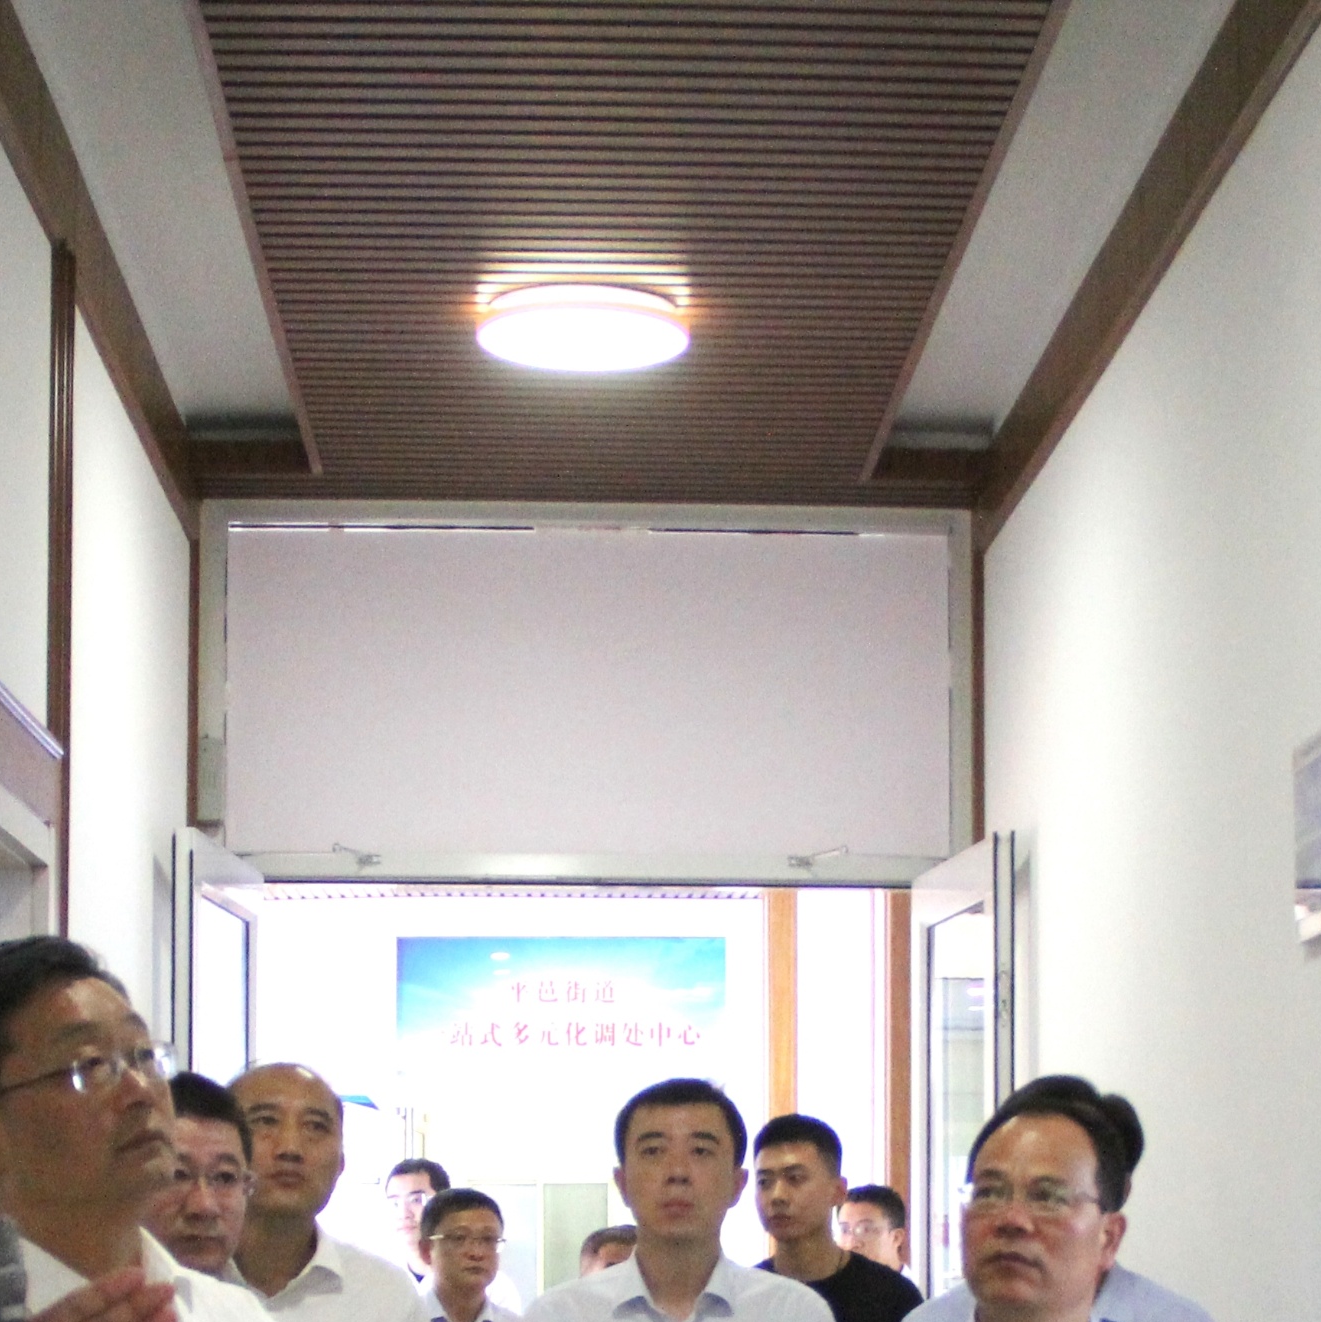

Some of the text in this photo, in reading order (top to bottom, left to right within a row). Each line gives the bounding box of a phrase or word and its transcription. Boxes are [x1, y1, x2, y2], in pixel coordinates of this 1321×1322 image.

[511, 980, 615, 1003] 平邑街道
[441, 1021, 701, 1047] 站式多元化调处中心
